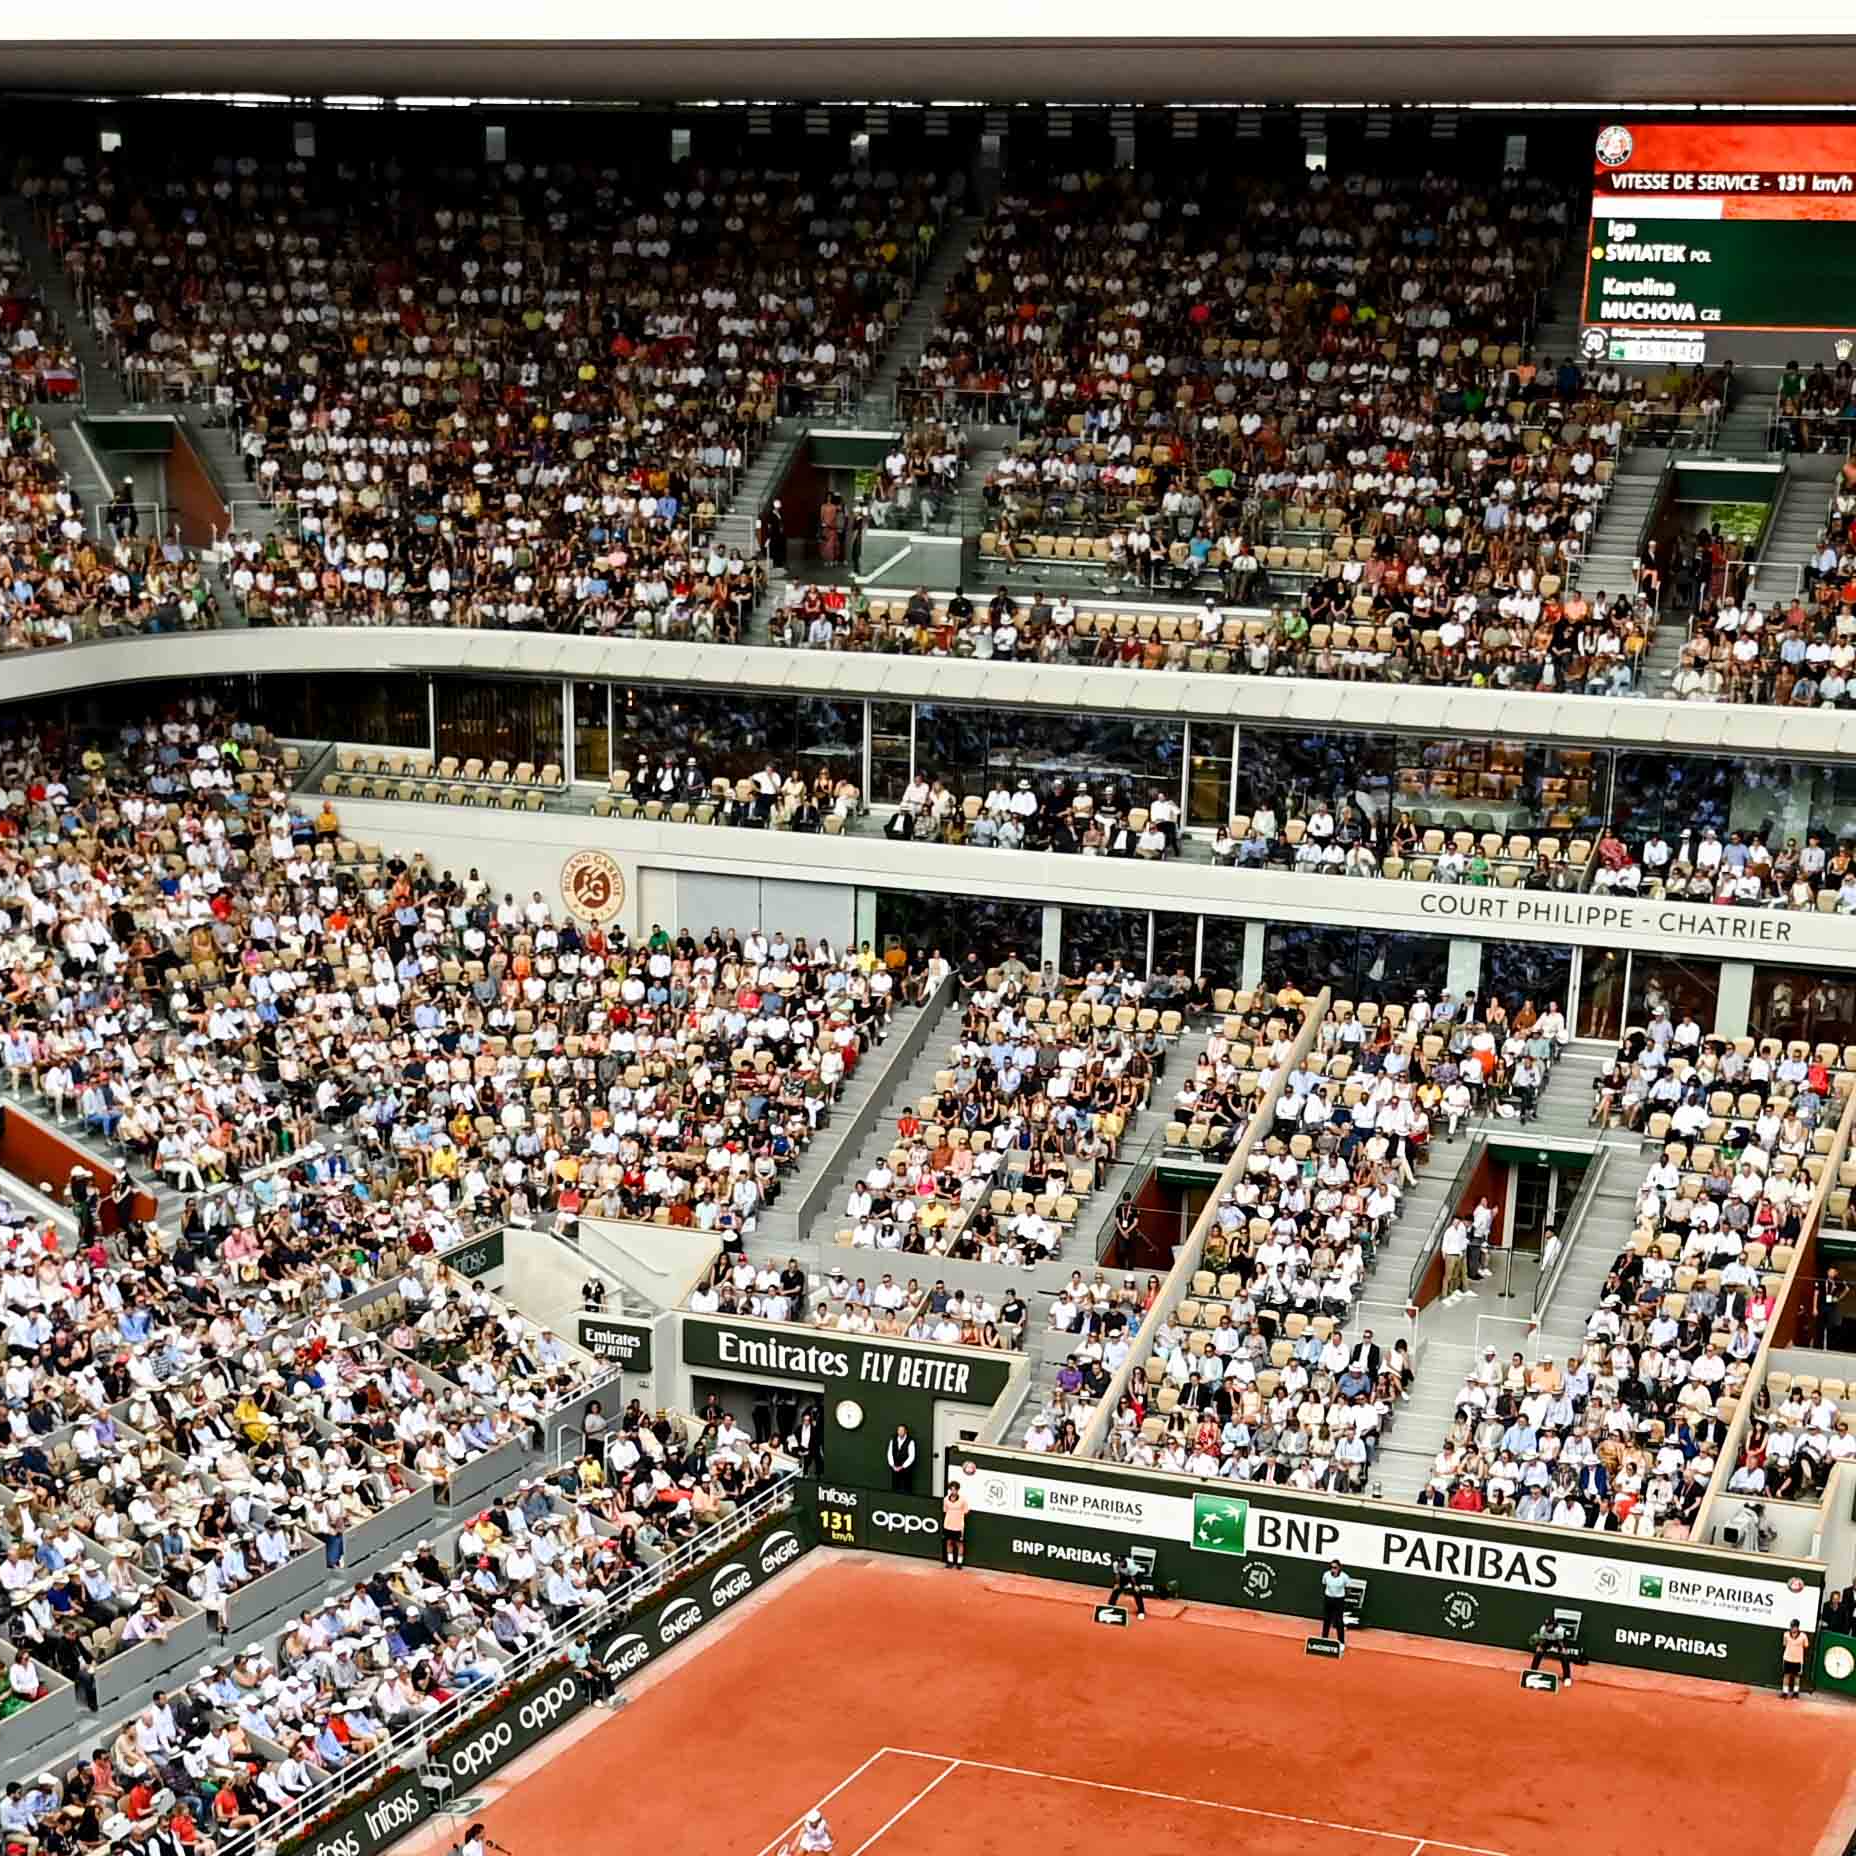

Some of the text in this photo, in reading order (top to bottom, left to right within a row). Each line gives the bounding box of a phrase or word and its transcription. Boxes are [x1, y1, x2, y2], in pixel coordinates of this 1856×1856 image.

[1611, 174, 1669, 191] VITESSE
[1673, 175, 1693, 190] DE
[1697, 174, 1759, 192] SERVICE
[1778, 176, 1805, 192] 131
[1812, 175, 1853, 192] km/h
[1608, 221, 1636, 238] Iga
[1606, 244, 1685, 263] SWIATEK
[1603, 278, 1675, 297] Karolina
[1601, 302, 1721, 321] MUCHOVA CZE
[1420, 894, 1508, 918] COURT
[1517, 902, 1633, 928] PHILIPPE
[1659, 913, 1791, 941] CHATRIER
[585, 1328, 640, 1348] Emirates
[608, 1346, 632, 1358] BETTER
[718, 1332, 970, 1394] Emirates FLY BETTER
[818, 1486, 857, 1507] Infosys
[1050, 1492, 1143, 1516] BNP PARIBAS
[820, 1510, 853, 1531] 131
[872, 1510, 939, 1534] oppo
[832, 1530, 855, 1543] km/h
[1012, 1539, 1112, 1566] BNP PARIBAS
[1258, 1515, 1339, 1555] BNP
[1382, 1533, 1557, 1589] PARIBAS
[1248, 1570, 1269, 1589] 50
[1669, 1580, 1774, 1606] BNP PARIBAS
[1450, 1600, 1472, 1619] 50
[1615, 1628, 1728, 1659] BNP PARIBAS
[519, 1677, 575, 1730] oppo
[452, 1721, 512, 1777] oppo
[364, 1787, 421, 1840] Infosys
